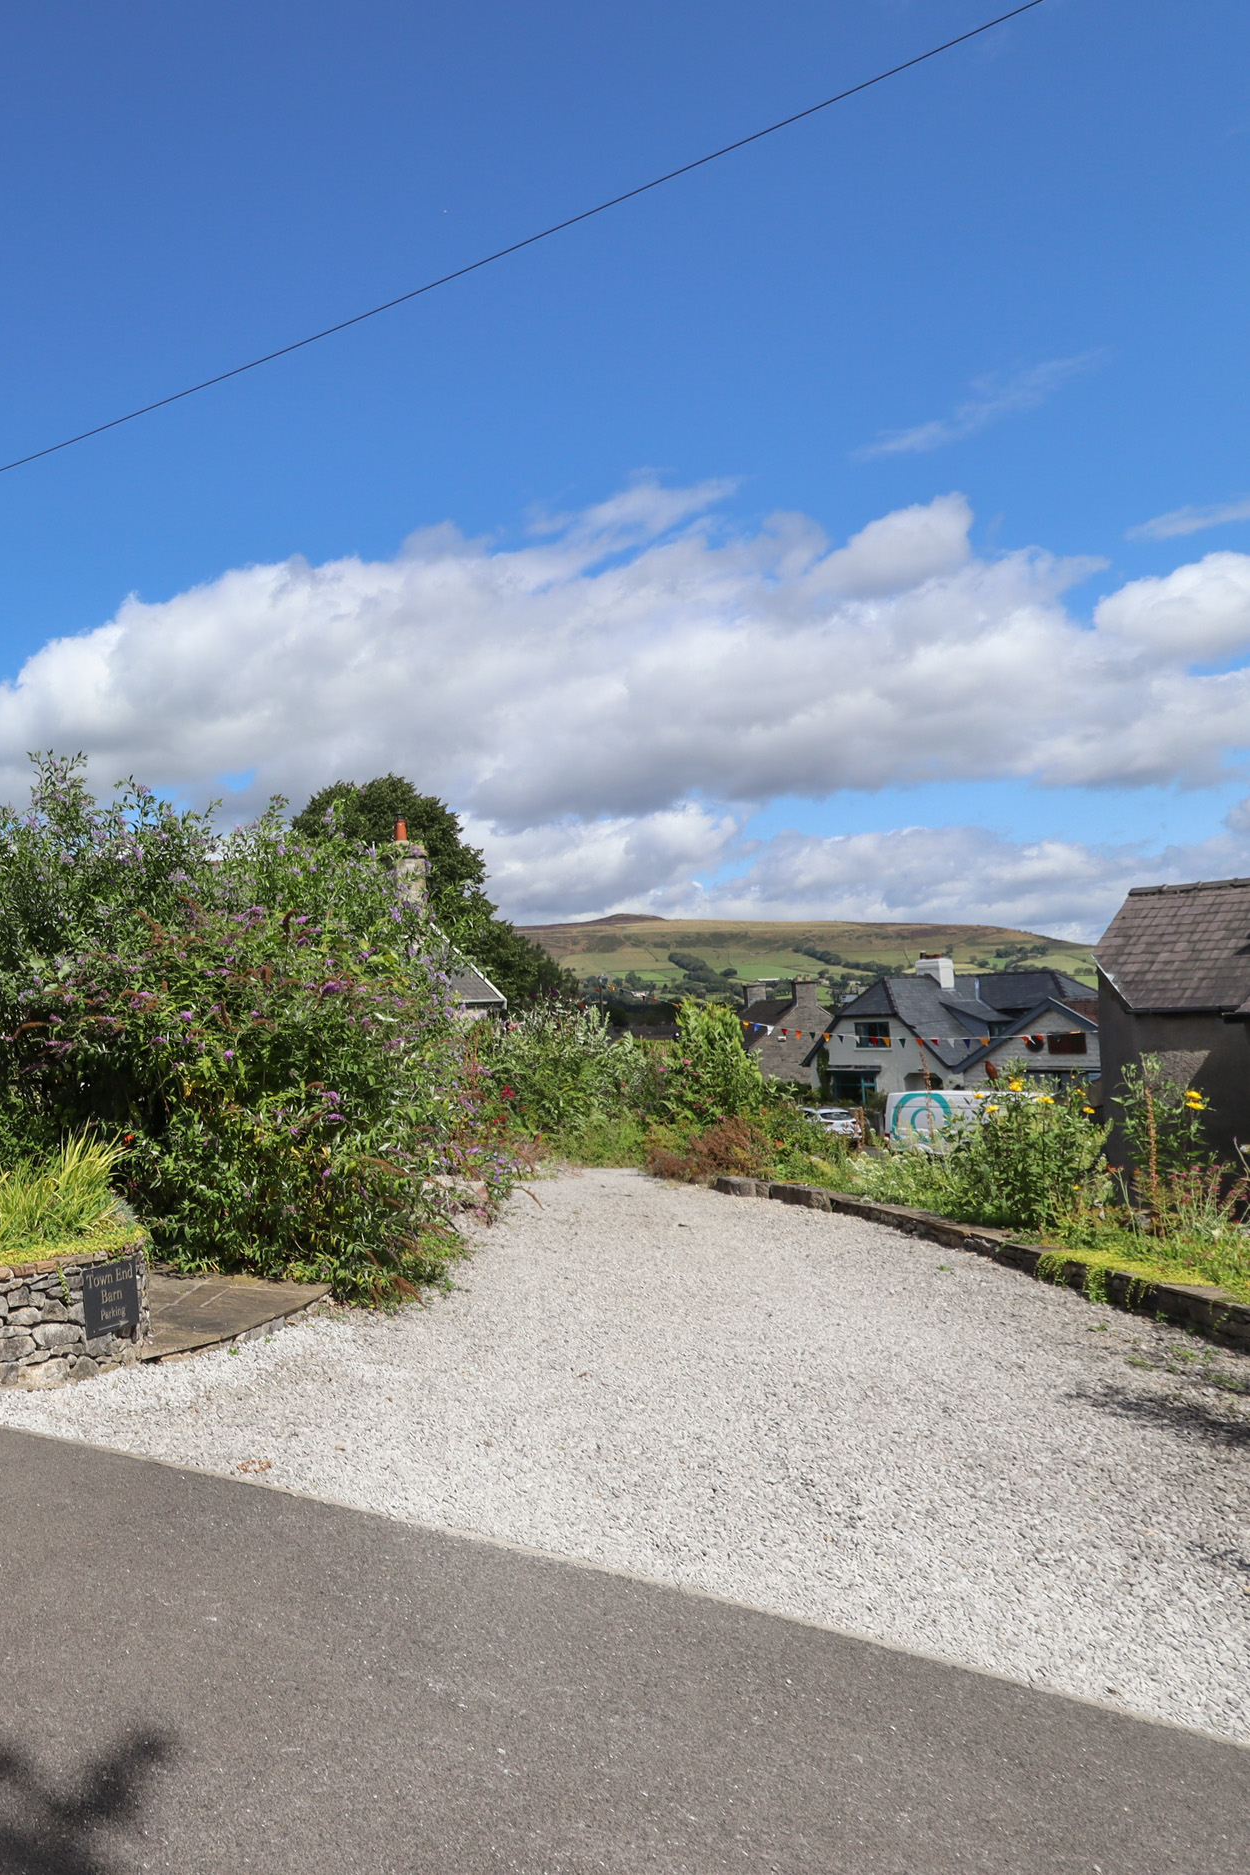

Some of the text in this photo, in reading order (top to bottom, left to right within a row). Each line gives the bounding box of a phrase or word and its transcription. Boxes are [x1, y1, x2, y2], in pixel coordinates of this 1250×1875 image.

[86, 1263, 133, 1289] Town End
[101, 1289, 123, 1304] Barn
[100, 1306, 126, 1320] Parking
